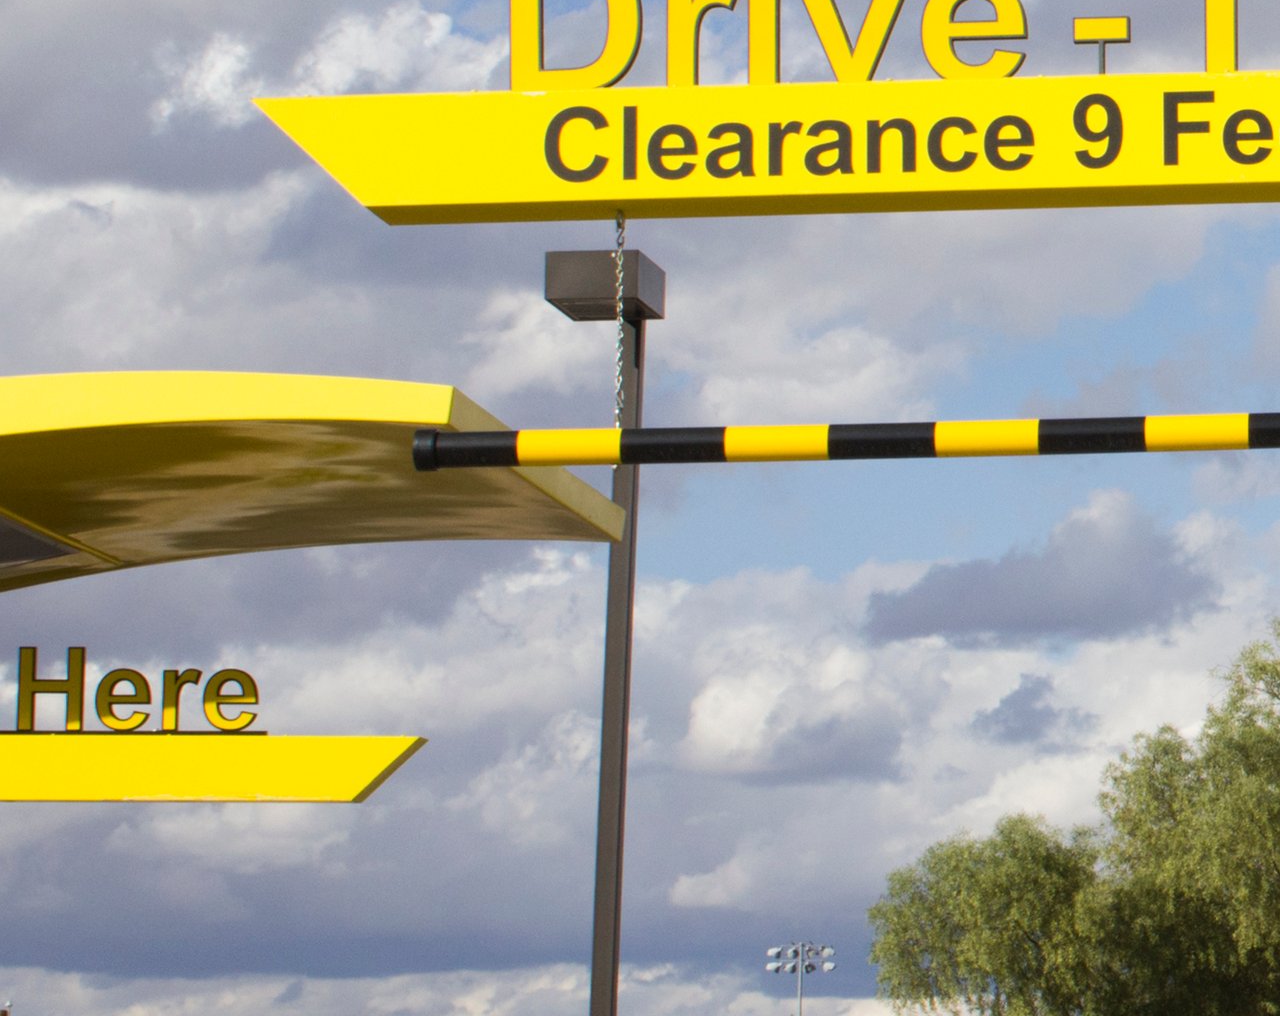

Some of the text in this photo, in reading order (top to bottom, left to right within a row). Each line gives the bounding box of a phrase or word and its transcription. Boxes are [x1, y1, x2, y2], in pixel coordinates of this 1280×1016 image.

[544, 106, 1036, 183] Clearance
[1072, 93, 1123, 169] 9
[16, 646, 260, 731] Here
